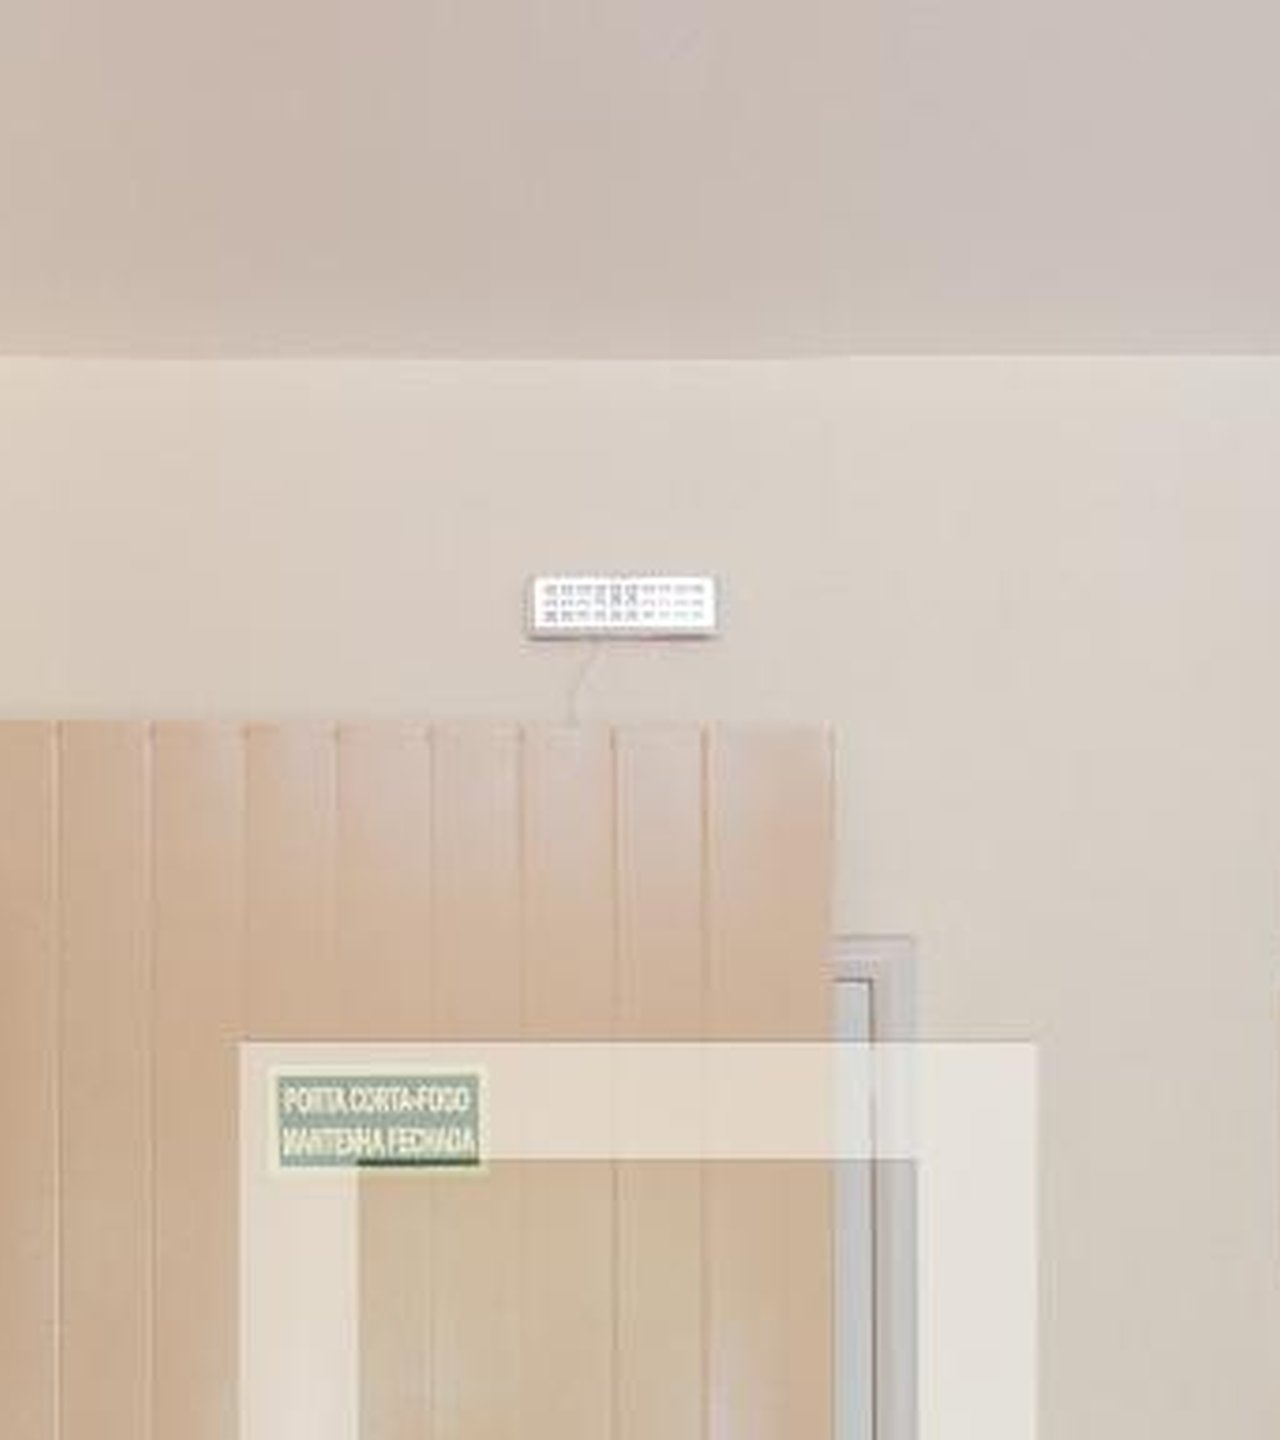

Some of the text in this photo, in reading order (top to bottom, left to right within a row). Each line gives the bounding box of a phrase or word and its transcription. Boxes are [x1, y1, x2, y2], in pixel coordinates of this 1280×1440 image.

[283, 1086, 469, 1112] PORTA CORTA-FOGO
[282, 1127, 476, 1157] MANTENHA FECHADA
